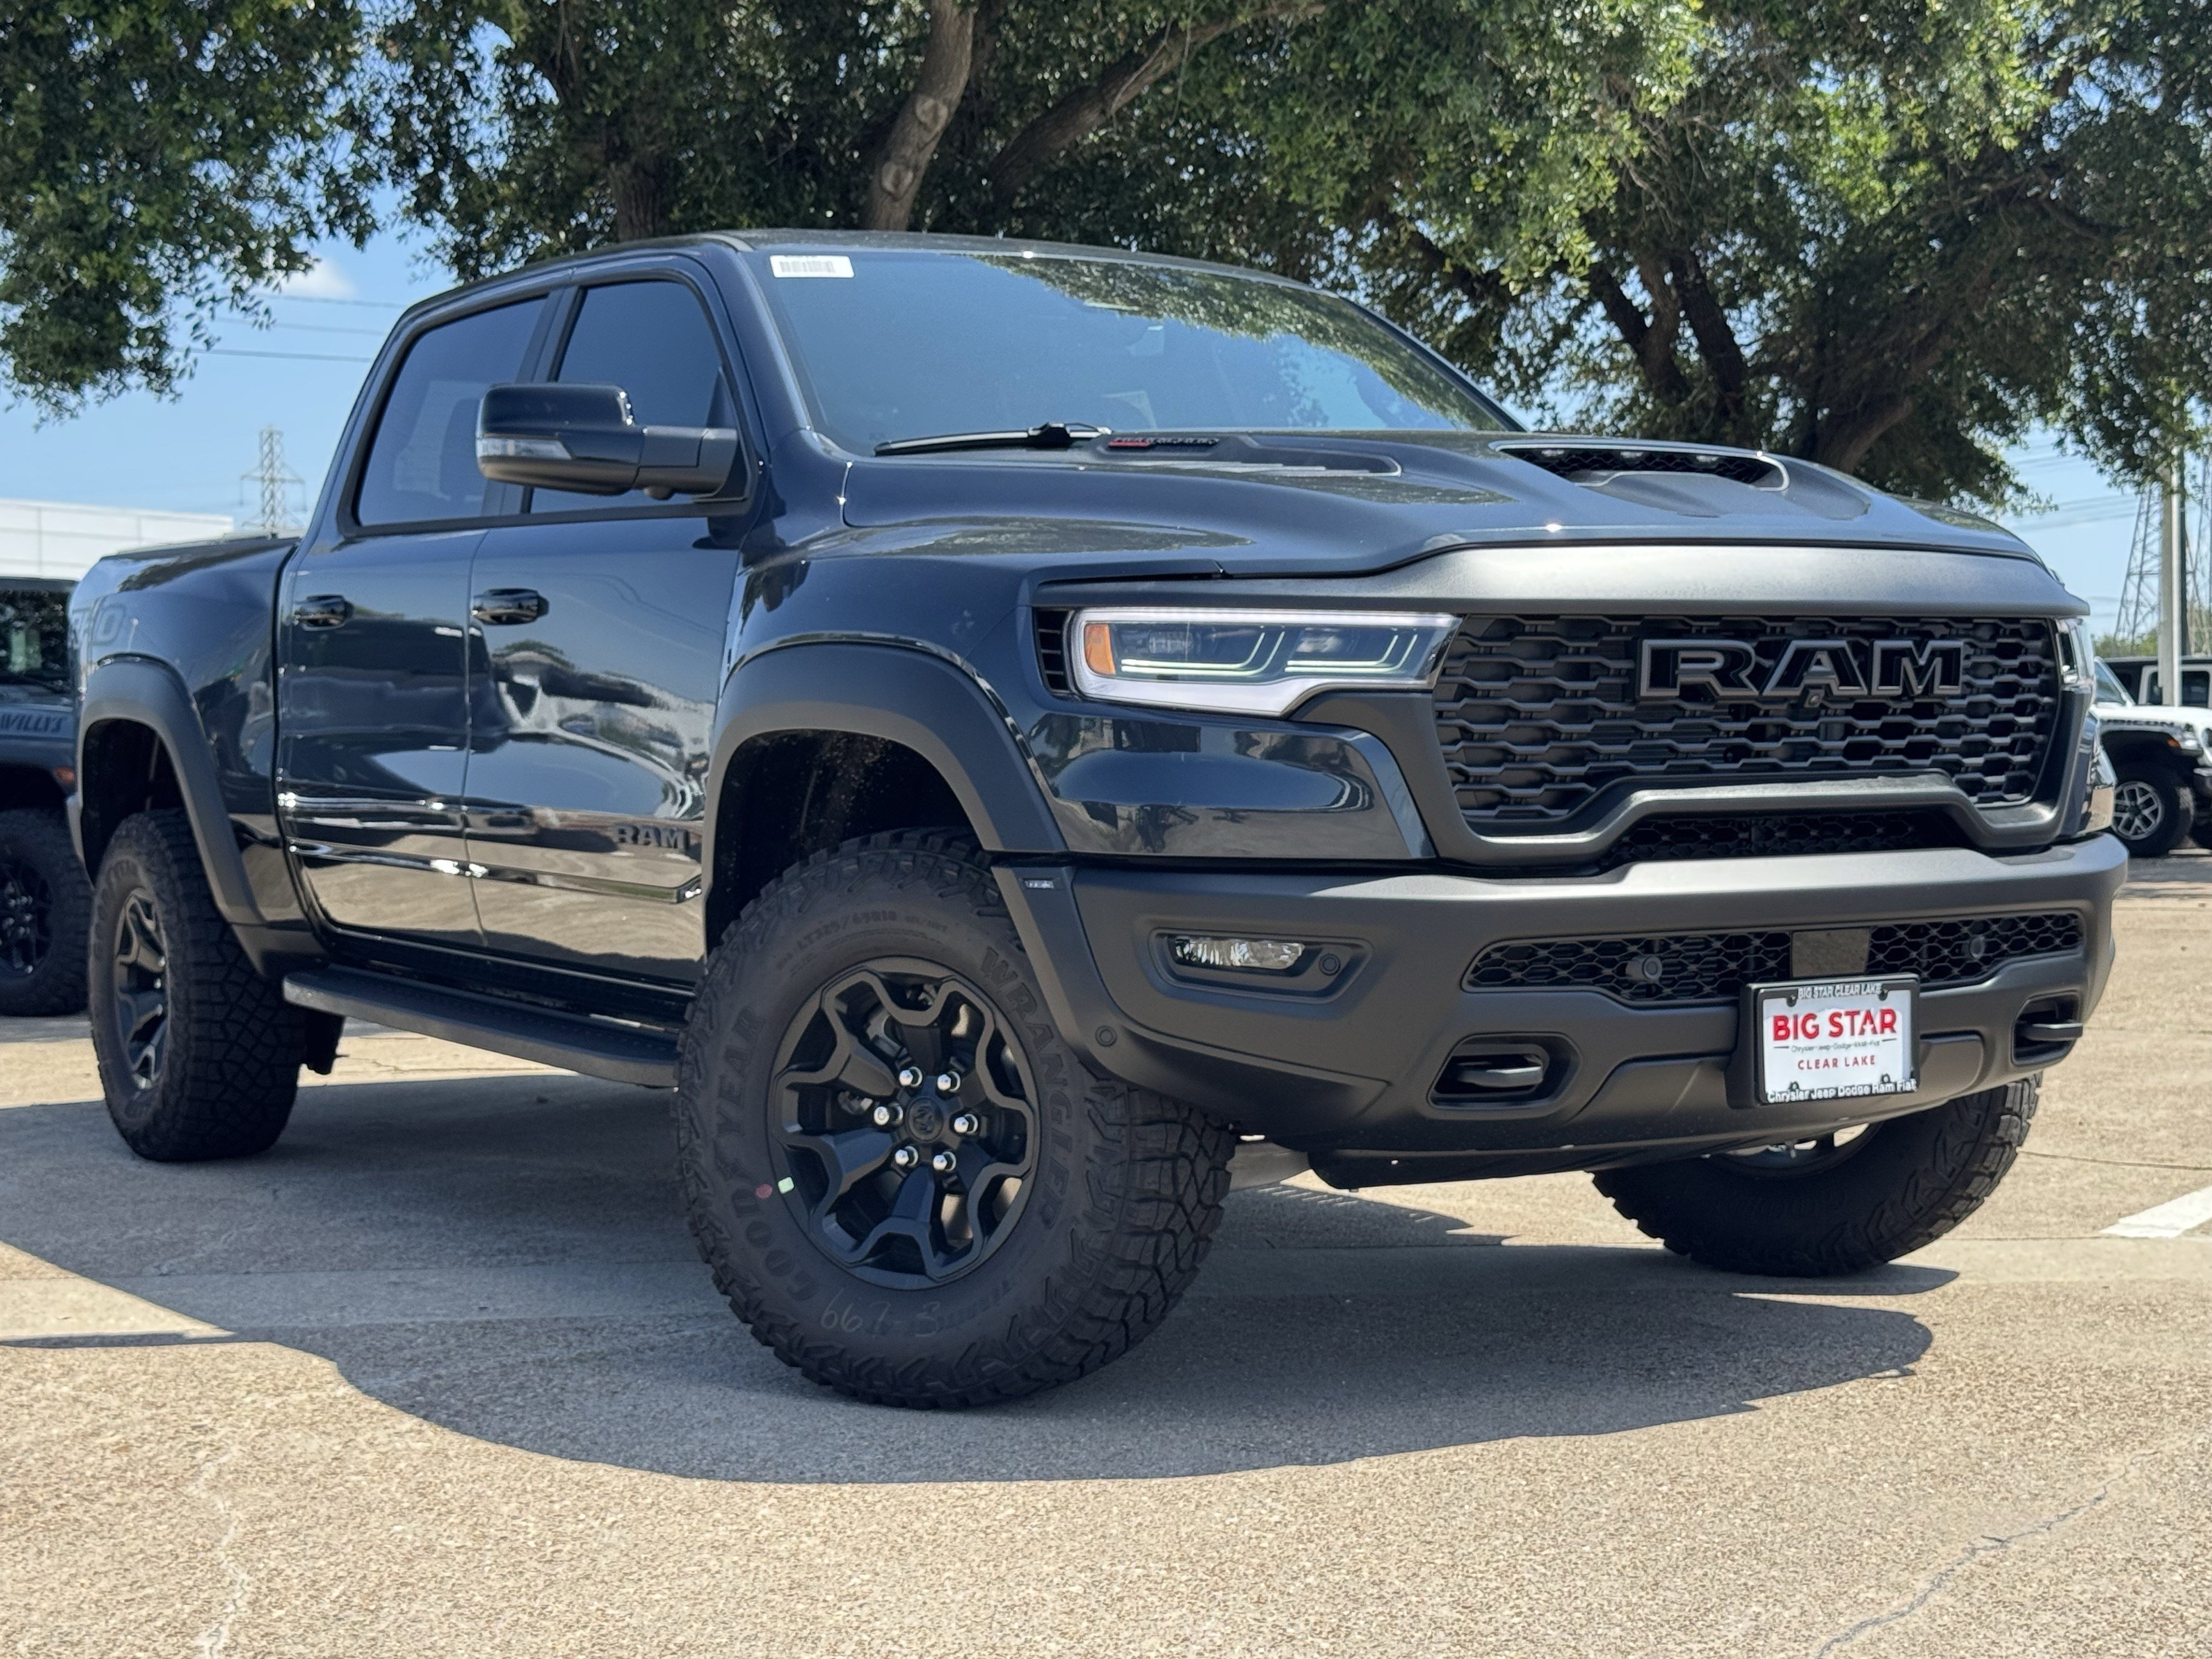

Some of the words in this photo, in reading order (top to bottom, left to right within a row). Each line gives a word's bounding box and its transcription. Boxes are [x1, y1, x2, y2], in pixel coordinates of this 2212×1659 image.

[1640, 639, 1963, 697] RAM
[612, 823, 689, 850] RAM
[1798, 987, 1812, 1000] BIG
[1813, 985, 1834, 998] STAR
[1835, 983, 1861, 997] CLEAR
[1861, 983, 1882, 995] LAKE
[1773, 1013, 1819, 1041] BIG
[1828, 1008, 1897, 1037] STAR
[1798, 1057, 1838, 1070] CLEAR
[1844, 1055, 1876, 1067] LAKE
[979, 945, 1073, 1229] WRANGLER
[1767, 1089, 1810, 1104] Chrysler
[1810, 1087, 1837, 1100] Jeep
[1837, 1085, 1871, 1098] Dodge
[1871, 1082, 1894, 1094] Ram
[1896, 1078, 1918, 1093] Fiat
